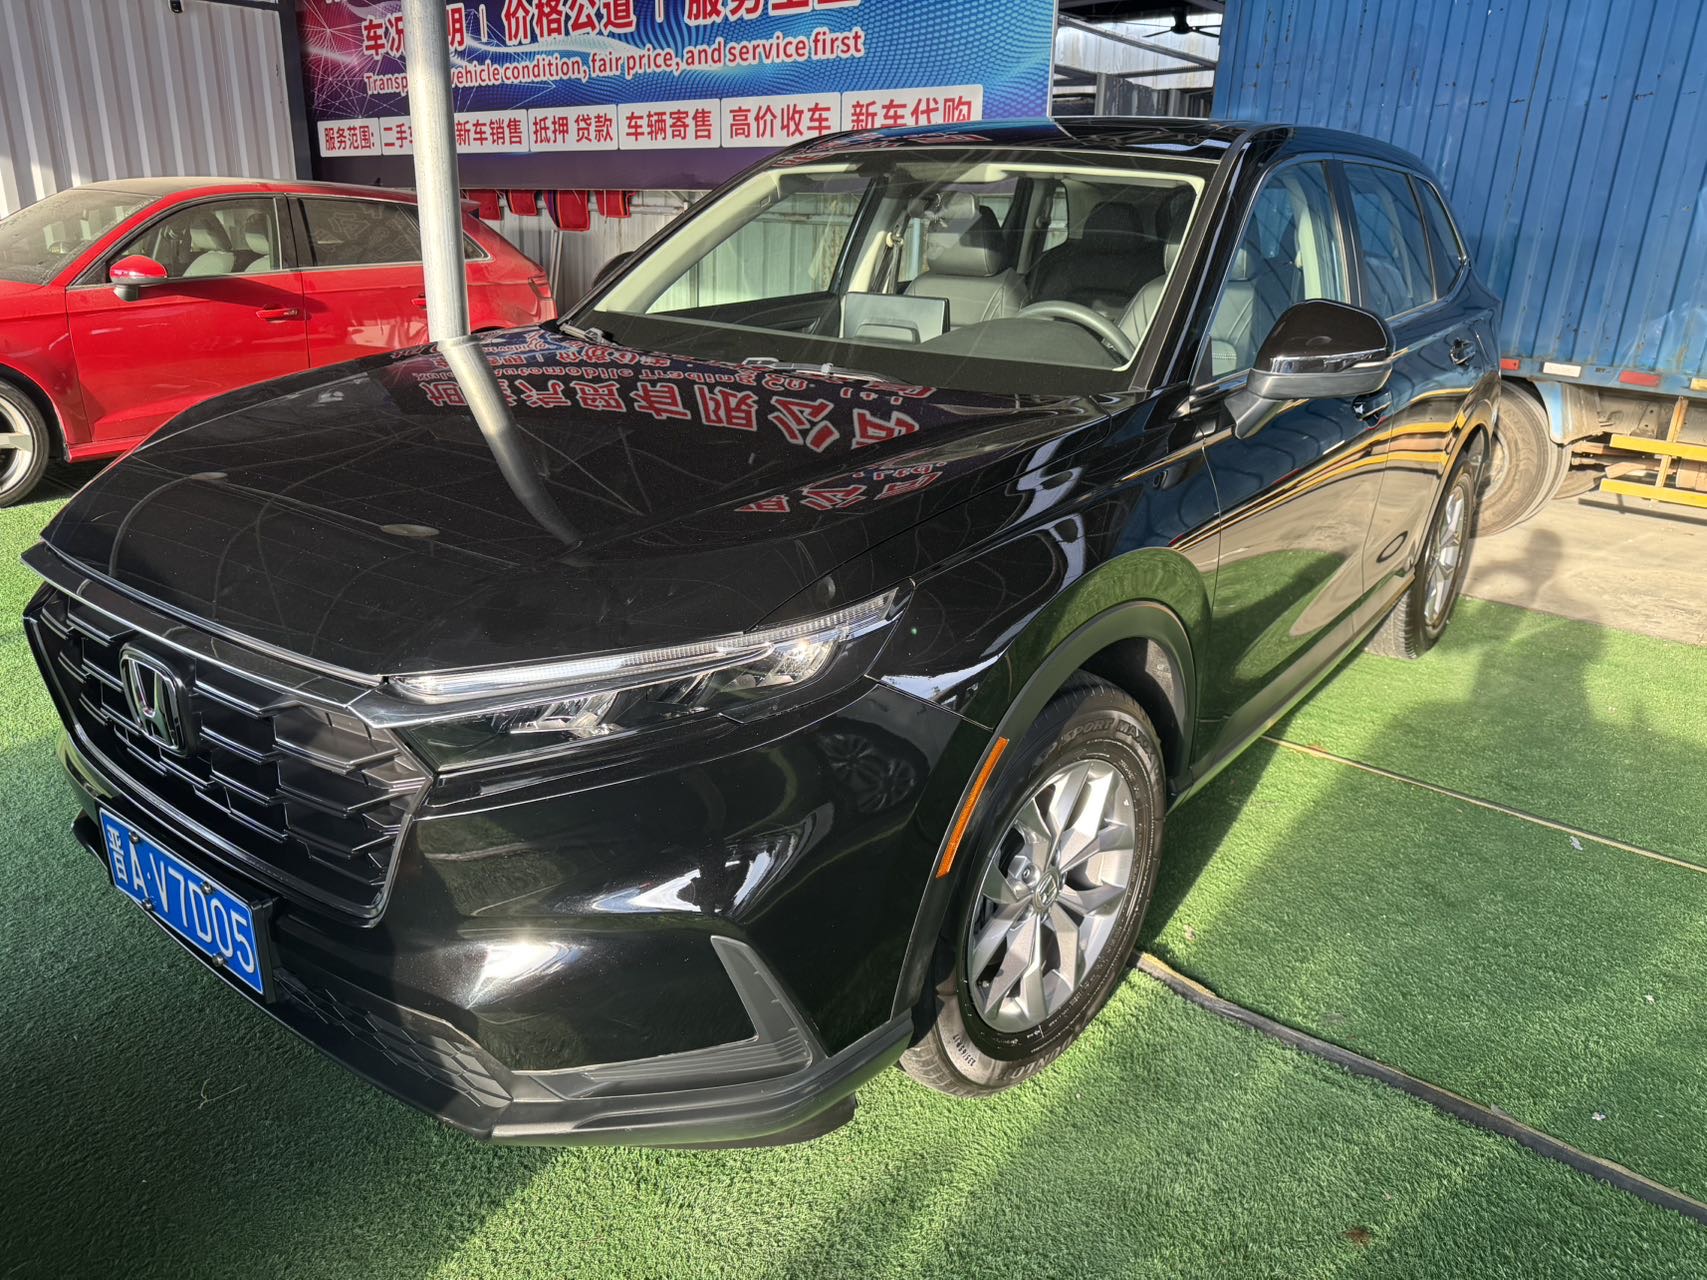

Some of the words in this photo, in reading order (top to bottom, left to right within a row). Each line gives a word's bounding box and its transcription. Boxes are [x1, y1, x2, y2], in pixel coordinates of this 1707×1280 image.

[504, 0, 634, 42] 价格公道
[503, 56, 588, 80] condition,
[591, 51, 623, 73] fair
[627, 47, 682, 75] price,
[685, 41, 722, 66] and
[728, 35, 807, 62] service
[812, 31, 862, 56] first
[625, 107, 713, 142] 车辆寄售
[728, 103, 832, 139] 高价收车
[851, 96, 972, 131] 新车代购
[455, 117, 523, 147] 新车销售
